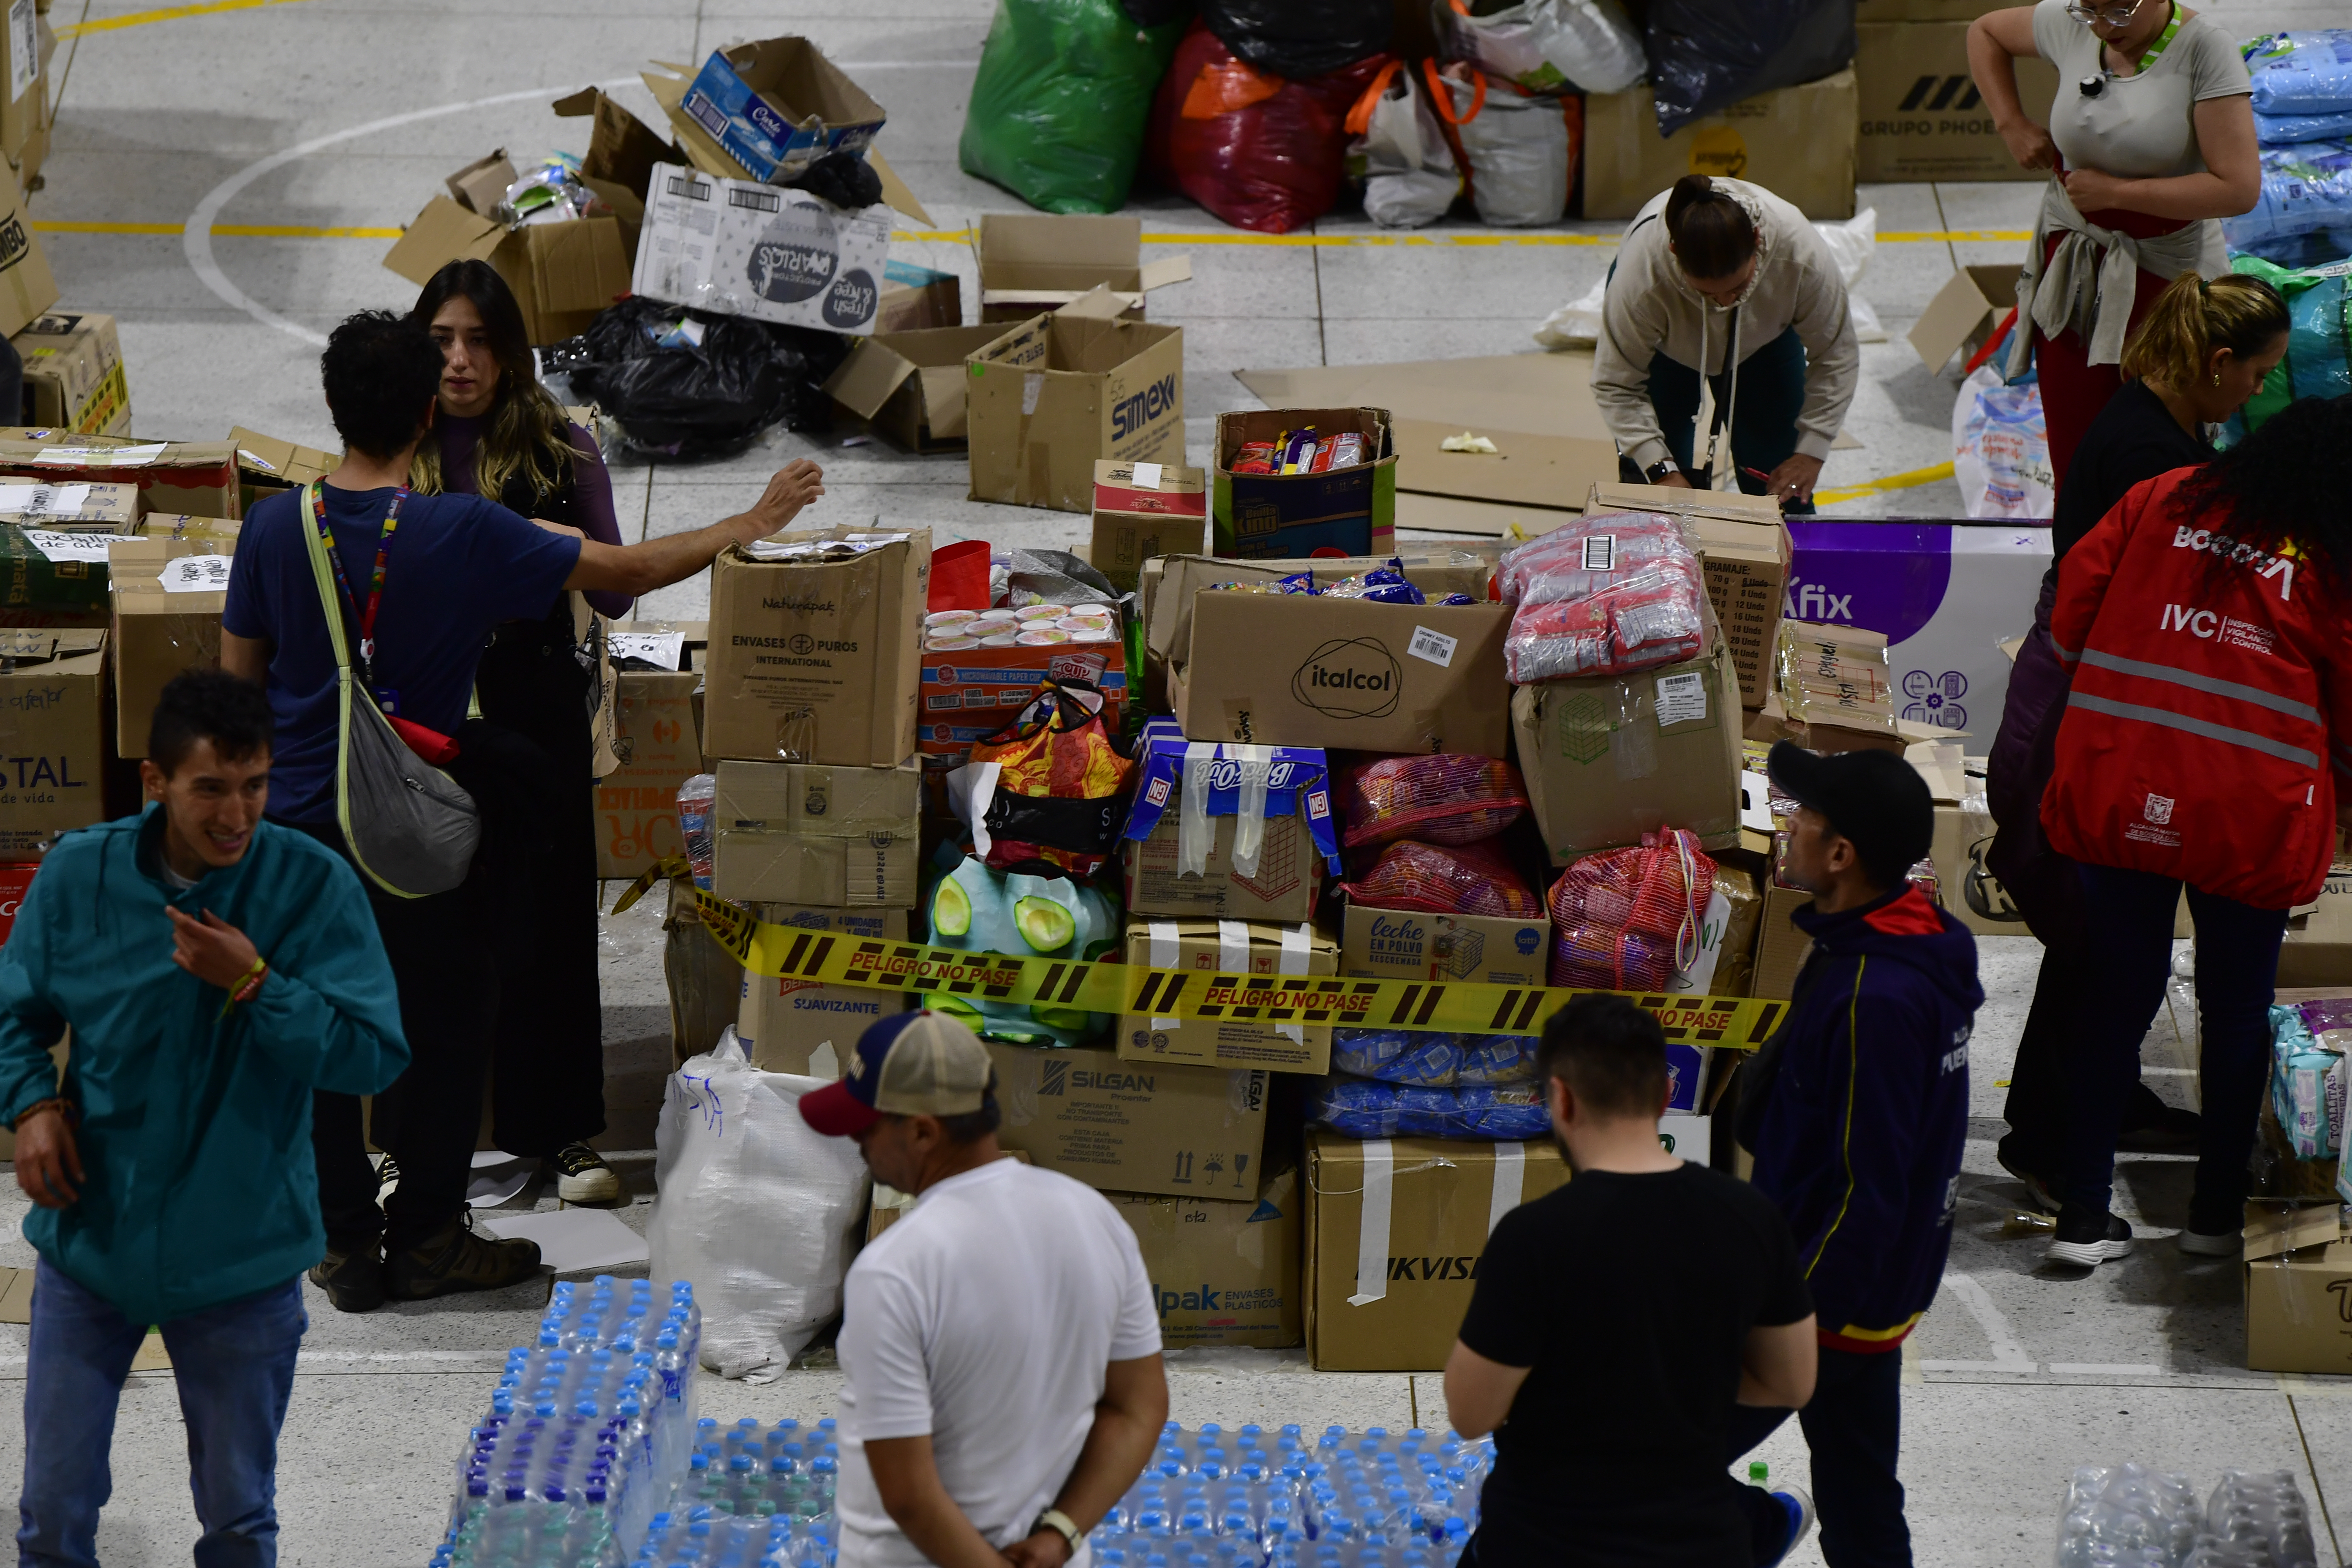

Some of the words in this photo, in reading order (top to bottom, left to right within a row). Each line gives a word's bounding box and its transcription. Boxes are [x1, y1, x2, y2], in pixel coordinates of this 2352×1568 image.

[1860, 120, 1933, 136] GRUPO
[1704, 561, 1751, 575] GRAMAJE:
[1713, 575, 1723, 583] 70
[1748, 590, 1767, 599] Unds
[762, 597, 836, 615] Naturapak
[1735, 601, 1745, 609] 12
[1747, 602, 1765, 611] Unds
[1734, 612, 1743, 620] 16
[1745, 613, 1764, 623] Unds
[2160, 603, 2218, 638] IVC
[1732, 624, 1742, 632] 18
[1743, 626, 1762, 635] Unds
[732, 635, 787, 649] ENVASES
[817, 640, 858, 652] PUROS
[1435, 636, 1451, 645] ADULTO
[1742, 638, 1760, 647] Unds
[2227, 627, 2273, 648] VIGILANCIA
[2231, 637, 2273, 656] CONTROL
[1729, 648, 1738, 656] 24
[1740, 650, 1759, 659] Unds
[756, 656, 833, 668] INTERNATIONAL
[1739, 661, 1757, 670] Unds
[961, 670, 1007, 682] MICROWAVABLE
[1008, 672, 1028, 681] PAPER
[1029, 672, 1042, 682] CUP
[1062, 664, 1090, 676] CUP
[1311, 664, 1390, 691] italcol
[1737, 672, 1756, 682] Unds
[1150, 782, 1168, 800] GN
[1, 793, 16, 803] de
[24, 792, 55, 803] vida
[597, 787, 682, 811] IPOFLACK
[1311, 795, 1326, 812] GN
[876, 850, 885, 873] 3226
[876, 874, 885, 885] 69
[876, 885, 885, 900] A02
[838, 916, 843, 925] 4
[845, 917, 883, 928] UNIDADES
[1371, 916, 1425, 941] leche
[1371, 938, 1385, 950] EN
[1388, 940, 1423, 954] POLVO
[1518, 935, 1537, 945] latti
[1369, 954, 1421, 966] DESCREMADA
[849, 953, 932, 976] PELIGRO
[936, 964, 964, 981] NO
[968, 967, 1019, 986] PASE
[794, 998, 879, 1014] SUAVIZANTE
[1204, 988, 1288, 1008] PELIGRO
[1292, 992, 1320, 1009] NO
[1323, 994, 1372, 1012] PASE
[1652, 1010, 1679, 1026] NO
[1683, 1012, 1732, 1029] PASE
[1070, 1101, 1113, 1110] IMPORTANTE
[2327, 1075, 2340, 1139] TOALLITAS
[1077, 1109, 1122, 1117] TRANSPORTE
[1073, 1116, 1130, 1125] CONTAMINANTES
[1058, 1135, 1092, 1143] CONTIENE
[1063, 1149, 1105, 1157] PRODUCTOS
[1355, 1256, 1476, 1280] IKVIS
[1225, 1288, 1274, 1300] ENVASES
[1225, 1298, 1284, 1310] PLASTICOS
